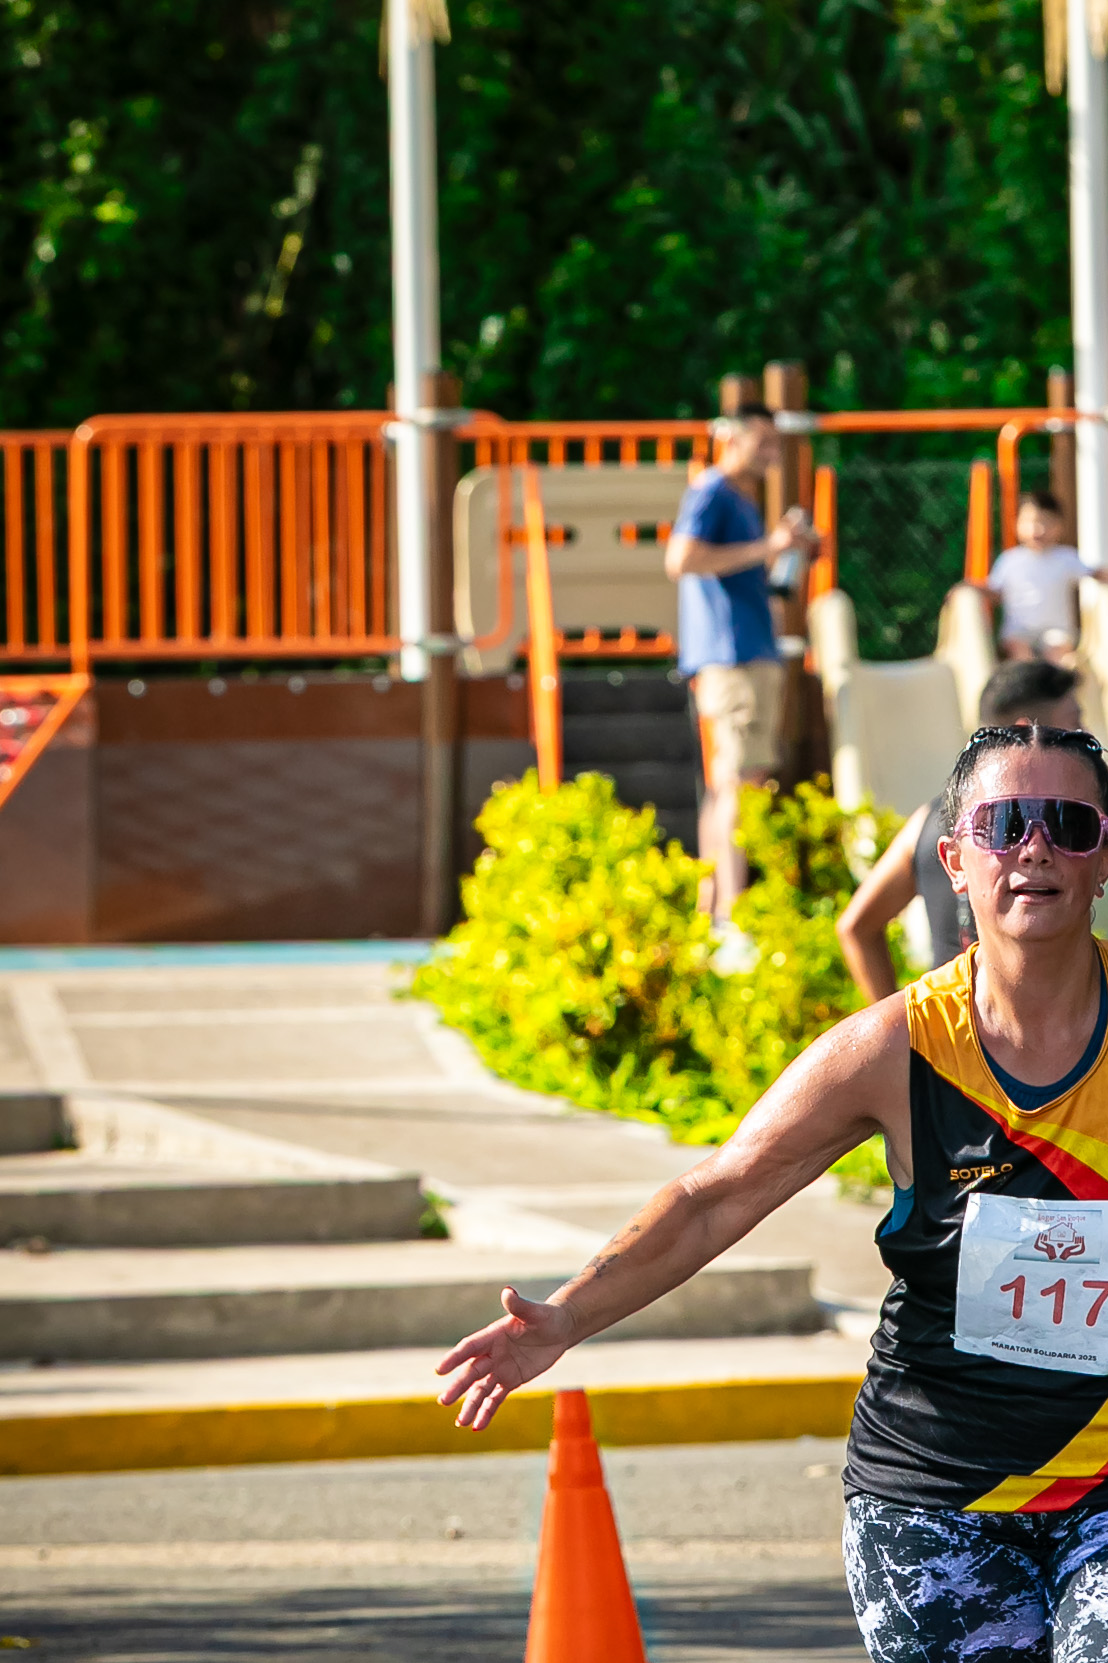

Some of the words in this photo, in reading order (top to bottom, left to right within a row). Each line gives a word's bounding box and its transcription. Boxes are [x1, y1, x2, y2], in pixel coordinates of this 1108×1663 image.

[950, 1163, 1014, 1181] SOTELO
[991, 1341, 1033, 1354] MARATON
[1033, 1348, 1077, 1360] SOLIDARIA
[1078, 1354, 1098, 1362] 2025
